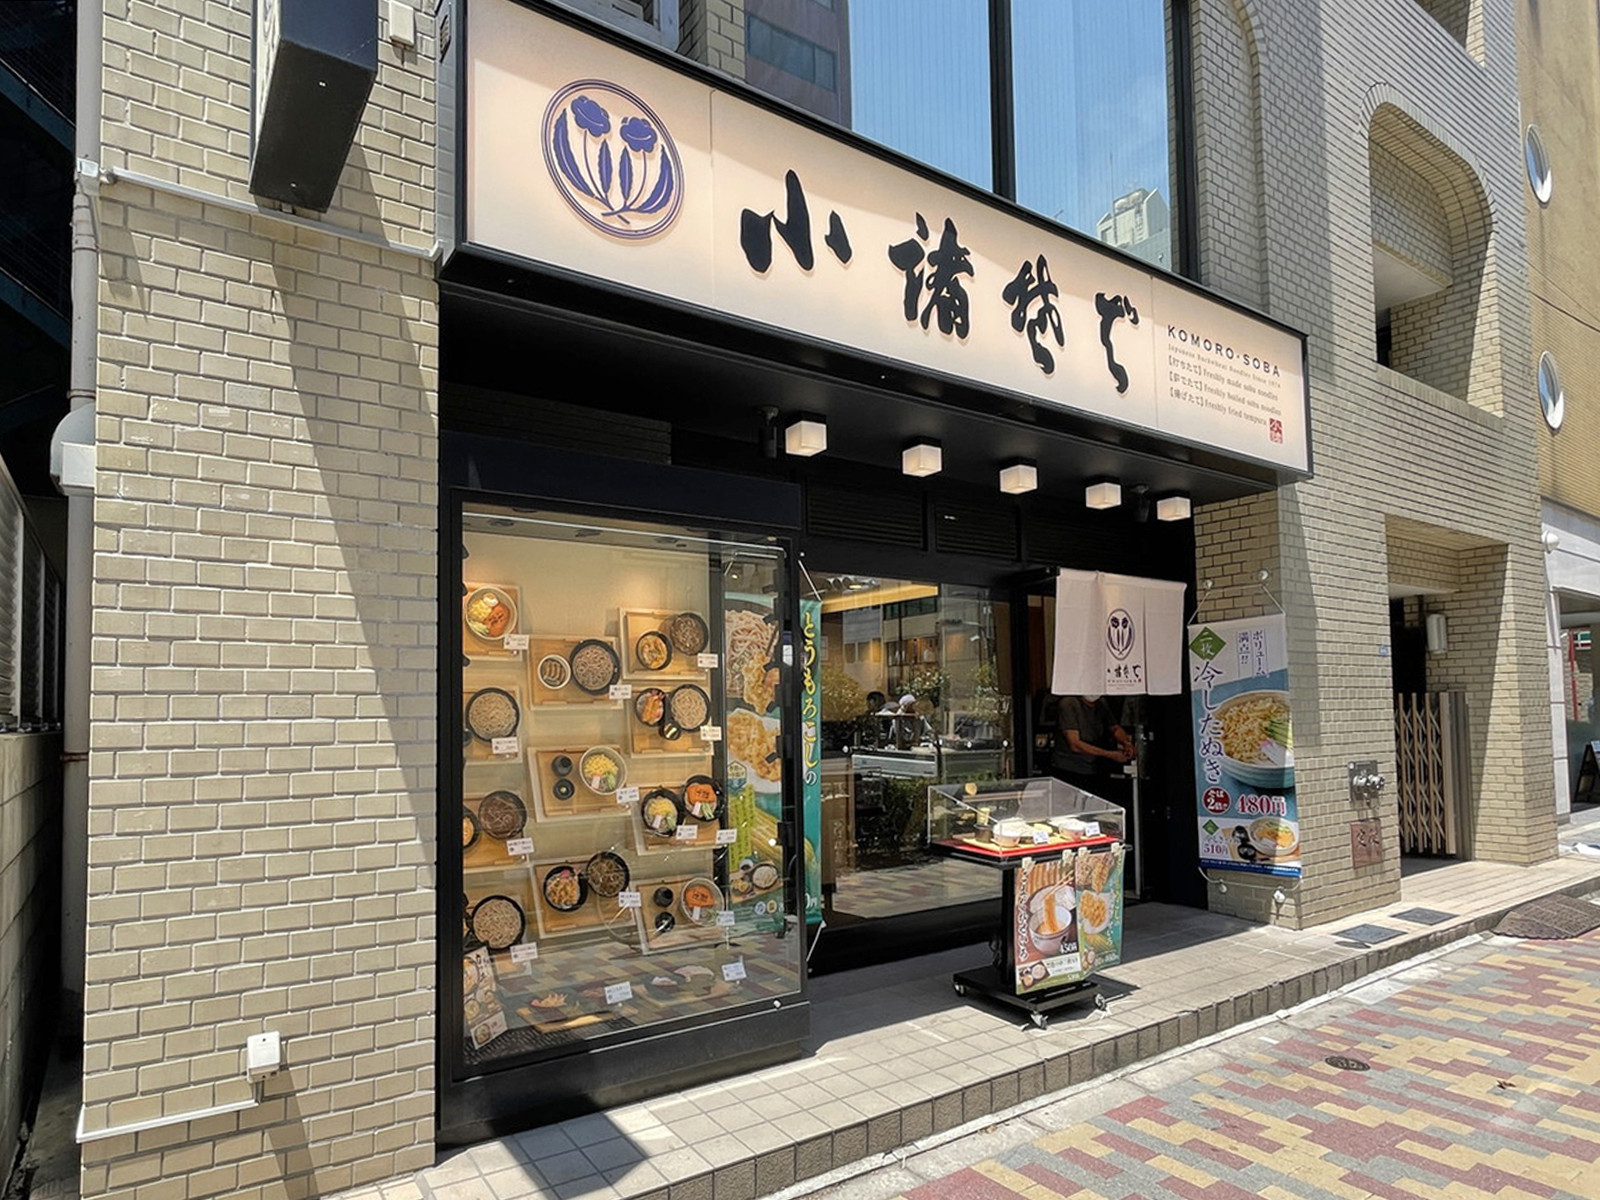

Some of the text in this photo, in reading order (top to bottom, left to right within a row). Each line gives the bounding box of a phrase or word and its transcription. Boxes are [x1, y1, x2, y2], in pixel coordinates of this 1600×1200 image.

[1253, 630, 1266, 676] ボリューム
[1194, 661, 1224, 782] 冷したぬき
[1238, 795, 1287, 815] 480円
